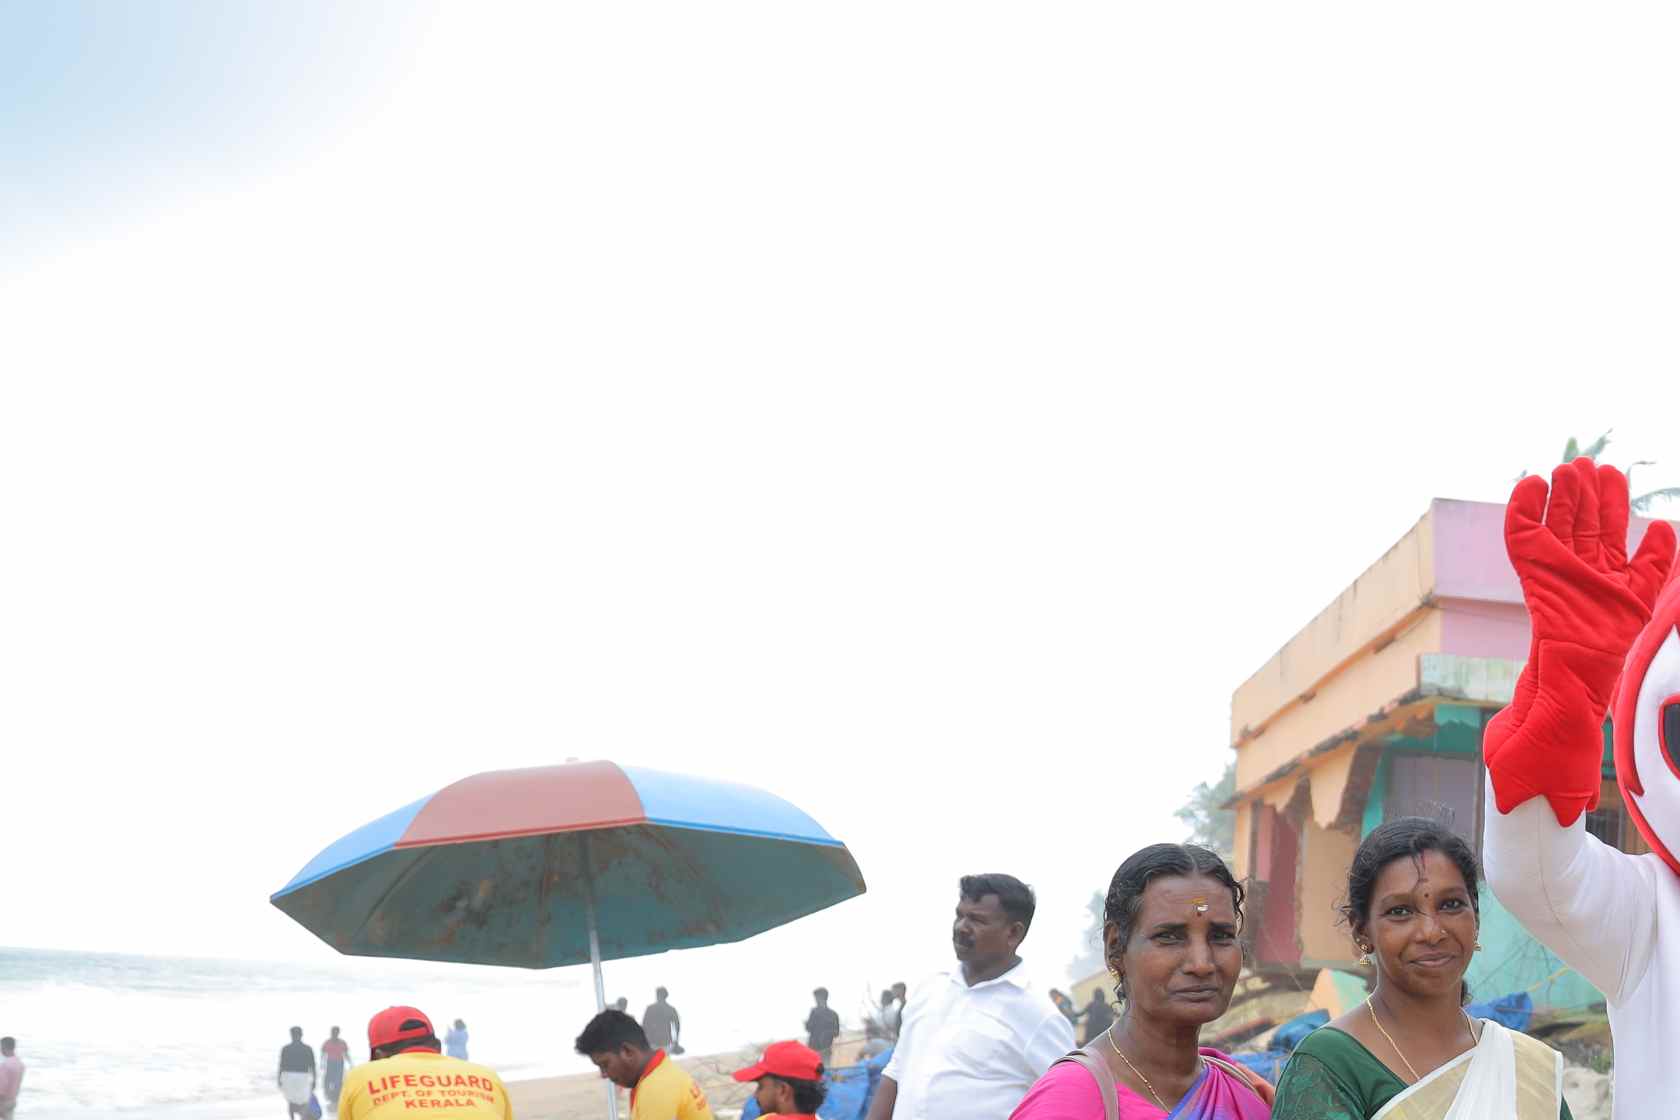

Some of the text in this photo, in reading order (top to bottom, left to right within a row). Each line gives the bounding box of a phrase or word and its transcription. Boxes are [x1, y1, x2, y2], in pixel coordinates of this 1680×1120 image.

[368, 1074, 493, 1095] LIFEGUARD
[440, 1089, 494, 1103] TOURISM
[404, 1098, 477, 1109] KERALA
